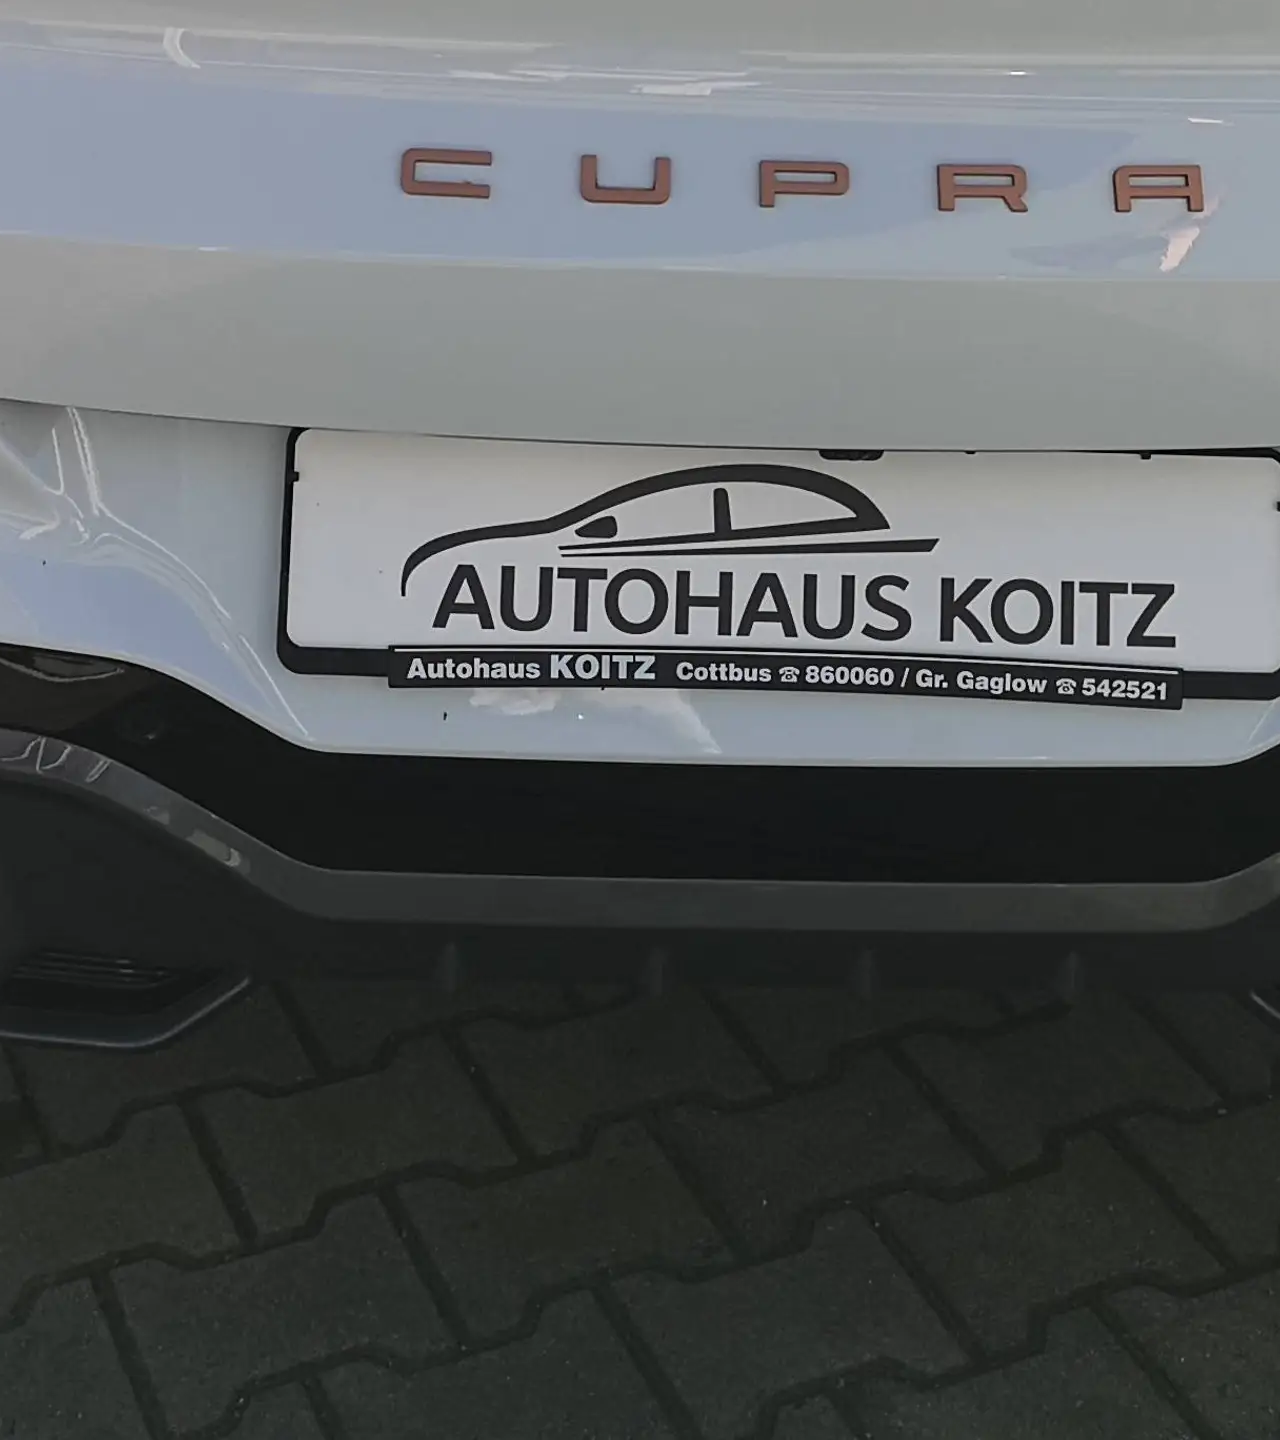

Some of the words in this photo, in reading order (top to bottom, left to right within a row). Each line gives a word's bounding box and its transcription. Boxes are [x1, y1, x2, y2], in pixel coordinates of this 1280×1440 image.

[400, 147, 1205, 213] CUPRA
[432, 564, 913, 641] AUTOHAUS
[939, 576, 1177, 648] KOITZ
[406, 658, 541, 680] Autohaus
[549, 654, 656, 680] KOITZ
[675, 661, 772, 683] Cottbus
[805, 665, 895, 686] 860060
[900, 667, 910, 688] /
[915, 669, 949, 688] Gr.
[956, 670, 1047, 696] Gaglow
[1081, 678, 1168, 701] 542521
